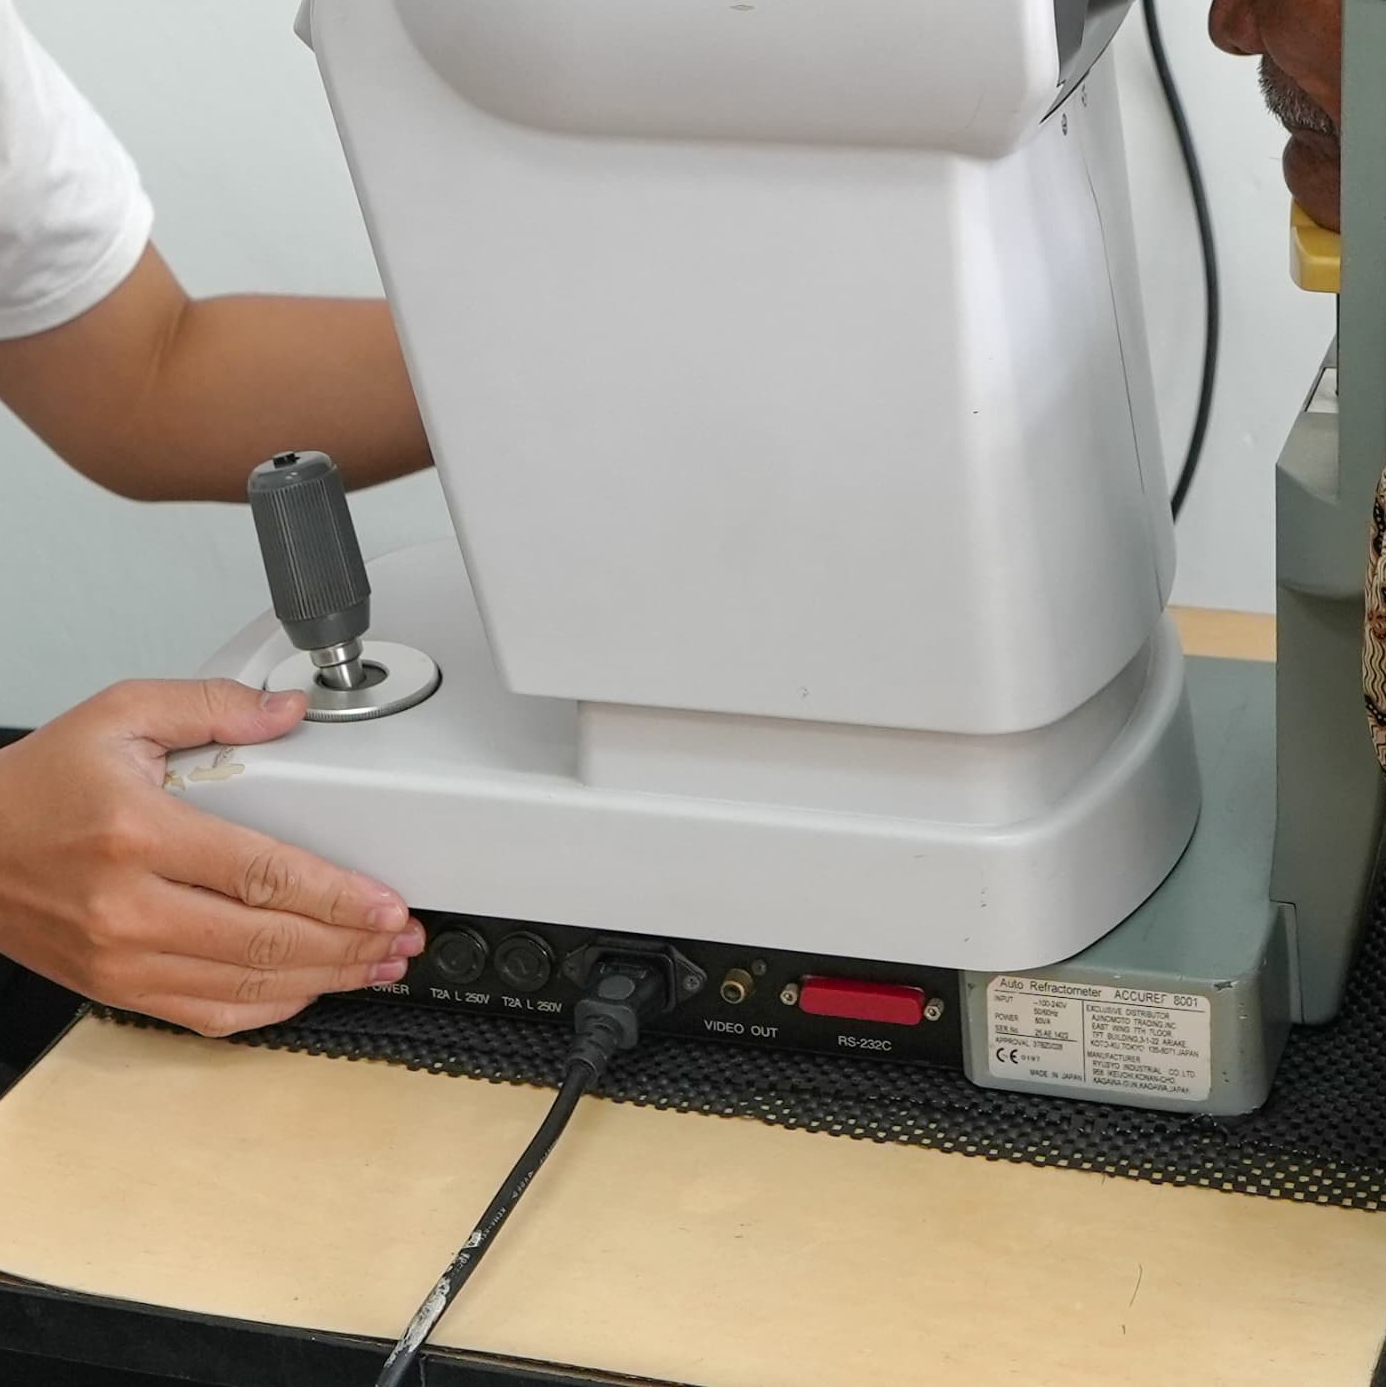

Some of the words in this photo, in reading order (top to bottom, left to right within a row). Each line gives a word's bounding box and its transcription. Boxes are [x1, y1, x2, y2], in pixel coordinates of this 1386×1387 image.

[365, 983, 410, 996] OWER
[430, 987, 450, 1000] T2A
[455, 991, 462, 1002] L
[465, 992, 490, 1004] 250V
[1000, 978, 1024, 990] Auto
[1030, 981, 1102, 997] Refractometer
[1174, 995, 1198, 1007] 8001
[502, 996, 522, 1008] T2A
[527, 1000, 533, 1010] L
[537, 1001, 562, 1013] 250V
[1086, 1004, 1122, 1015] EXCLUSIVE
[1126, 1008, 1170, 1019] DISTRIBUTOR
[995, 1012, 1019, 1021] POWER
[1092, 1014, 1131, 1024] AJINOMOTO
[704, 1020, 744, 1034] VIDEO
[750, 1024, 778, 1038] OUT
[1092, 1022, 1109, 1030] EAST
[838, 1035, 892, 1051] RS-232C
[1087, 1051, 1140, 1063] MANUFACTURER
[1030, 1069, 1049, 1078] MADE
[1061, 1072, 1082, 1081] JAPAN
